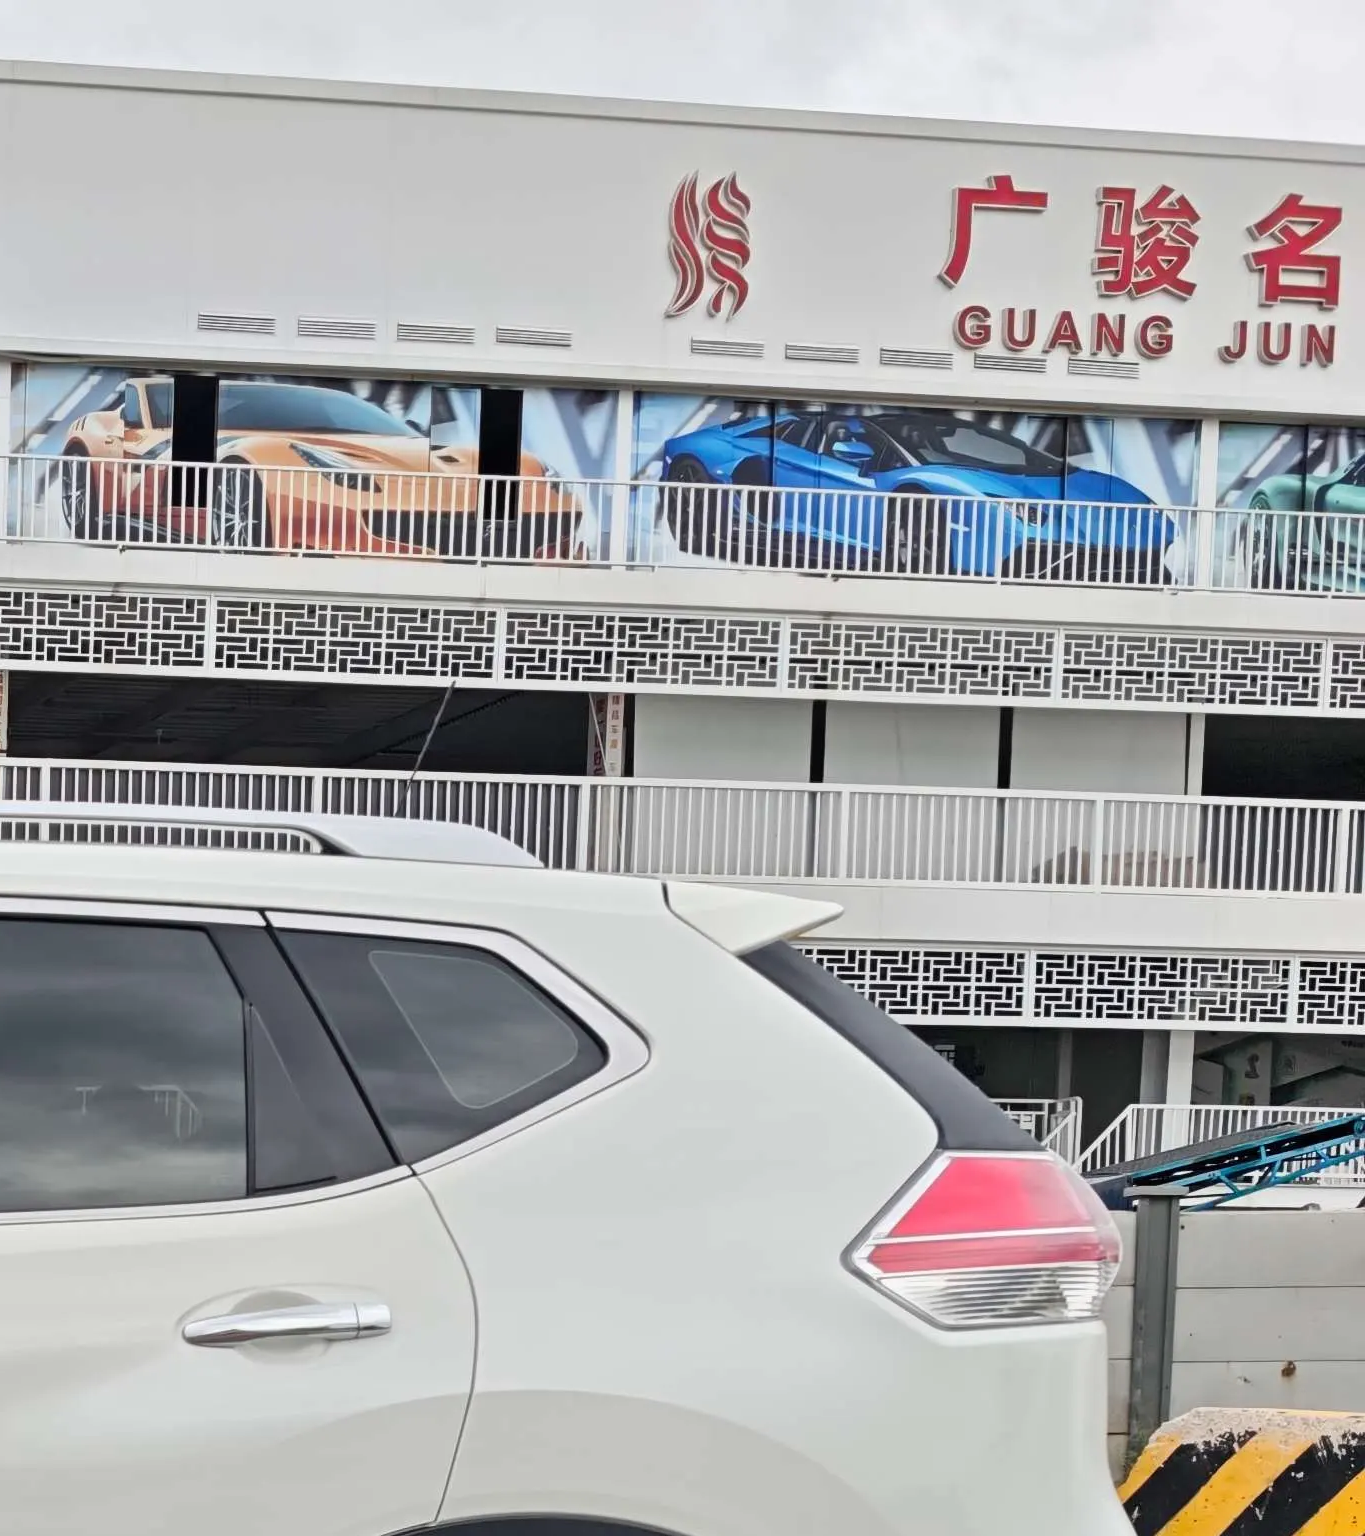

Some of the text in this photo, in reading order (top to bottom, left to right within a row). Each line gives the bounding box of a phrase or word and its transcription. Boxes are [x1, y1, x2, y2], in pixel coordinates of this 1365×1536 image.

[937, 174, 1345, 310] 广骏名
[953, 305, 1337, 368] GUANG JUN
